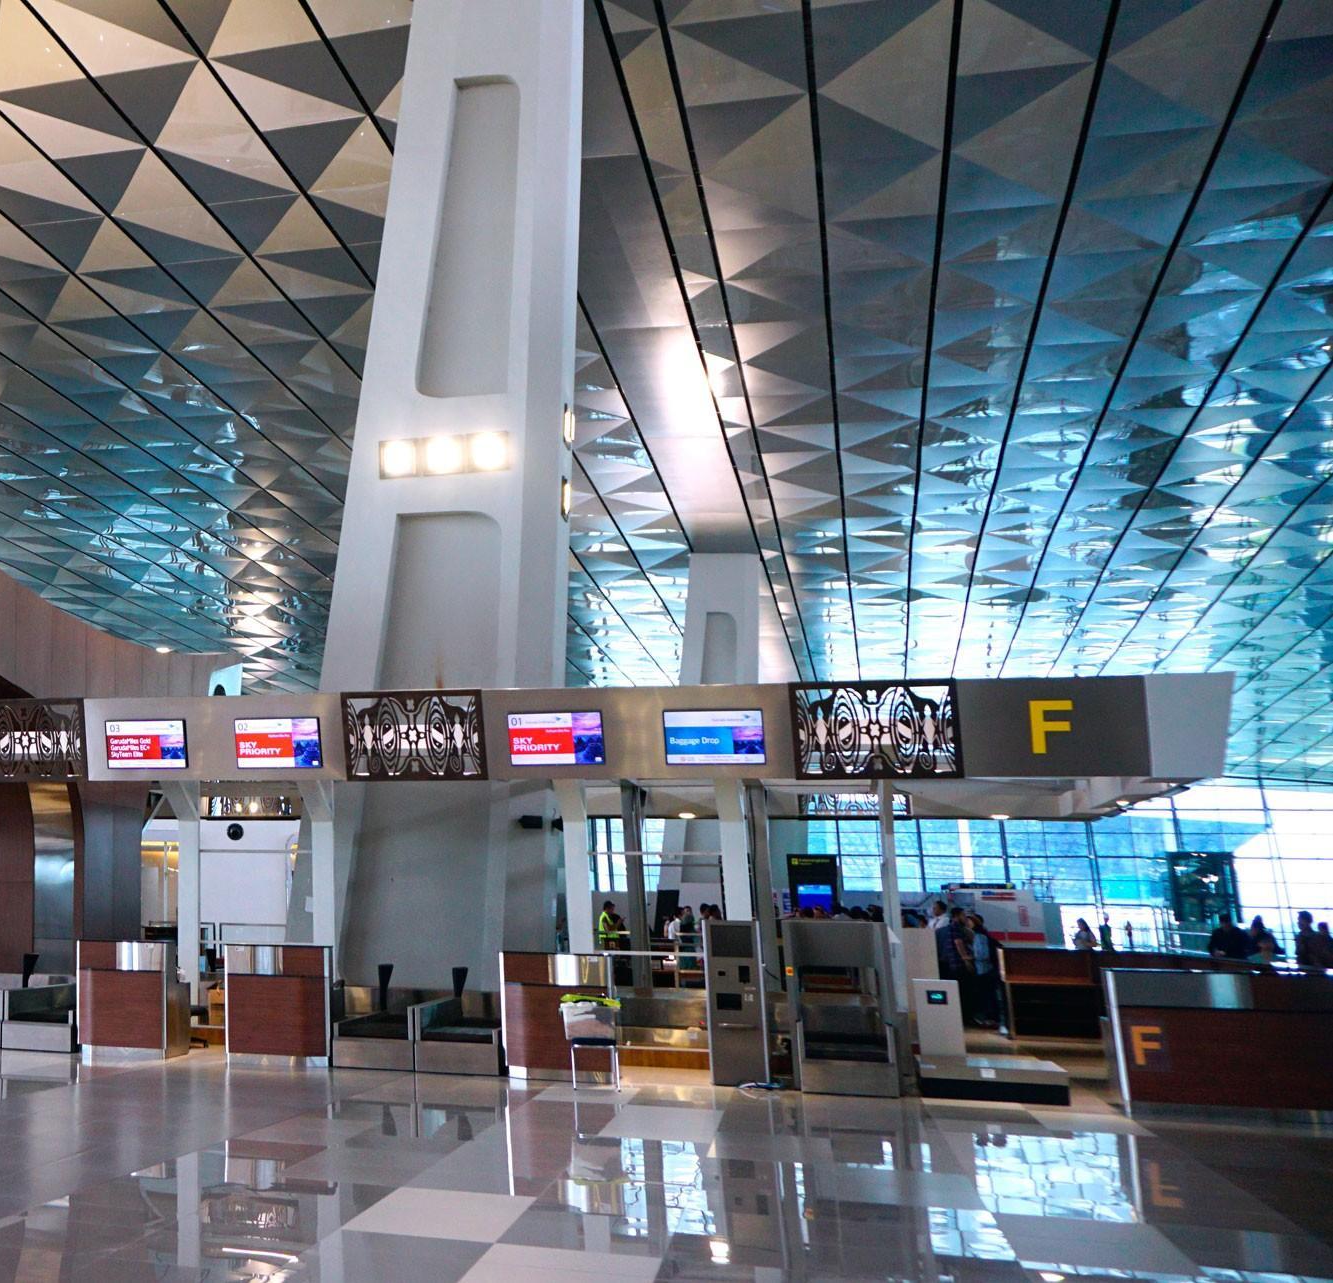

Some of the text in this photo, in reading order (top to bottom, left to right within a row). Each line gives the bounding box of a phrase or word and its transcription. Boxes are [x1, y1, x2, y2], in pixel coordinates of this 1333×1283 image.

[511, 717, 522, 726] 01
[110, 724, 120, 732] 03
[238, 723, 248, 731] 02
[1029, 700, 1073, 754] F
[669, 736, 720, 746] Baggage Drop
[1130, 1026, 1161, 1065] F
